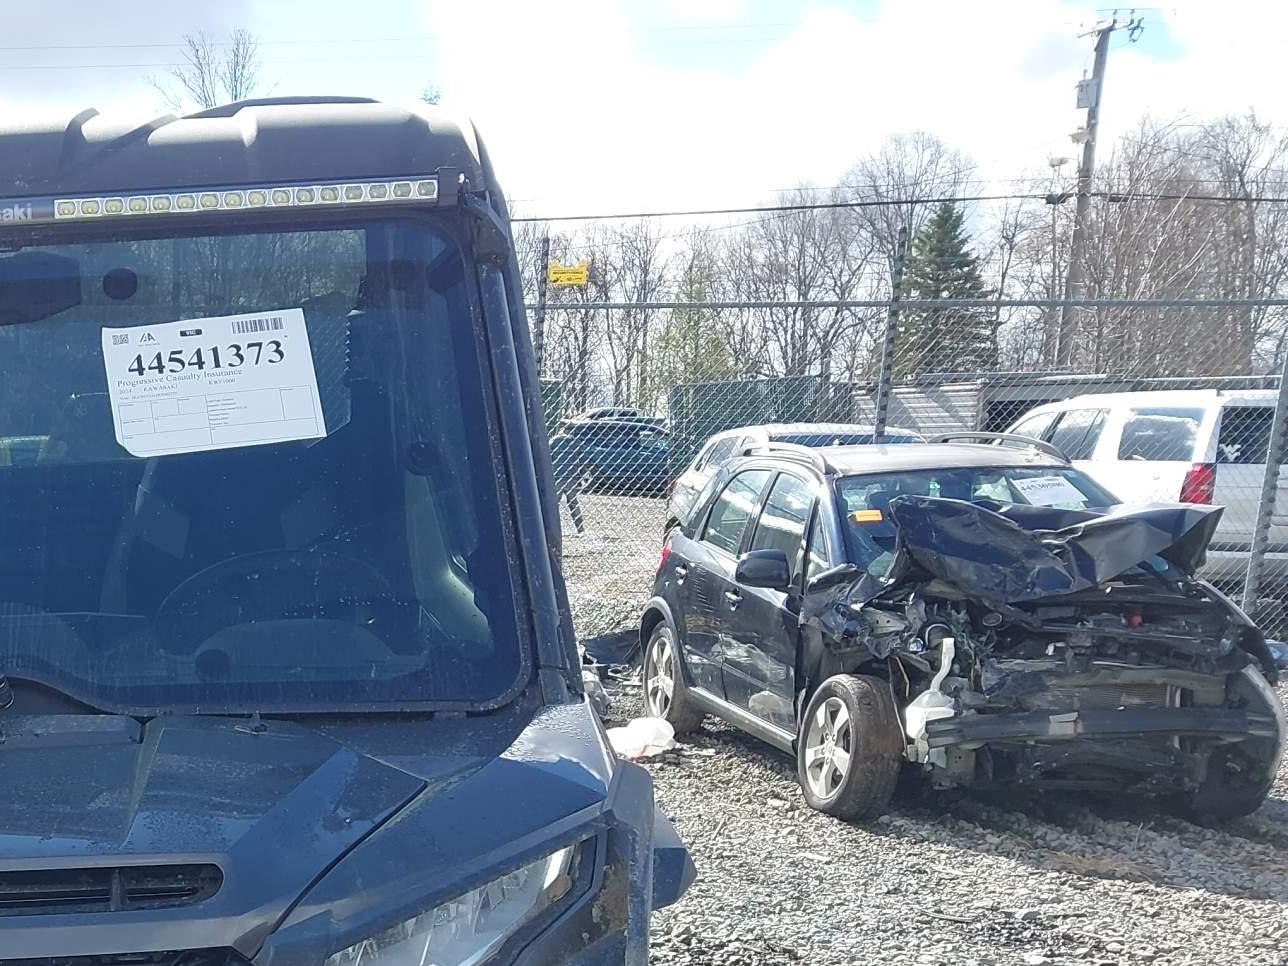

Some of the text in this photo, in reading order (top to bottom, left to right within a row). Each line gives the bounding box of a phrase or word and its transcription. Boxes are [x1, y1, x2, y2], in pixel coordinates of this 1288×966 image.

[127, 340, 285, 376] 44541373
[117, 369, 243, 388] Progressive Casualty Insurance
